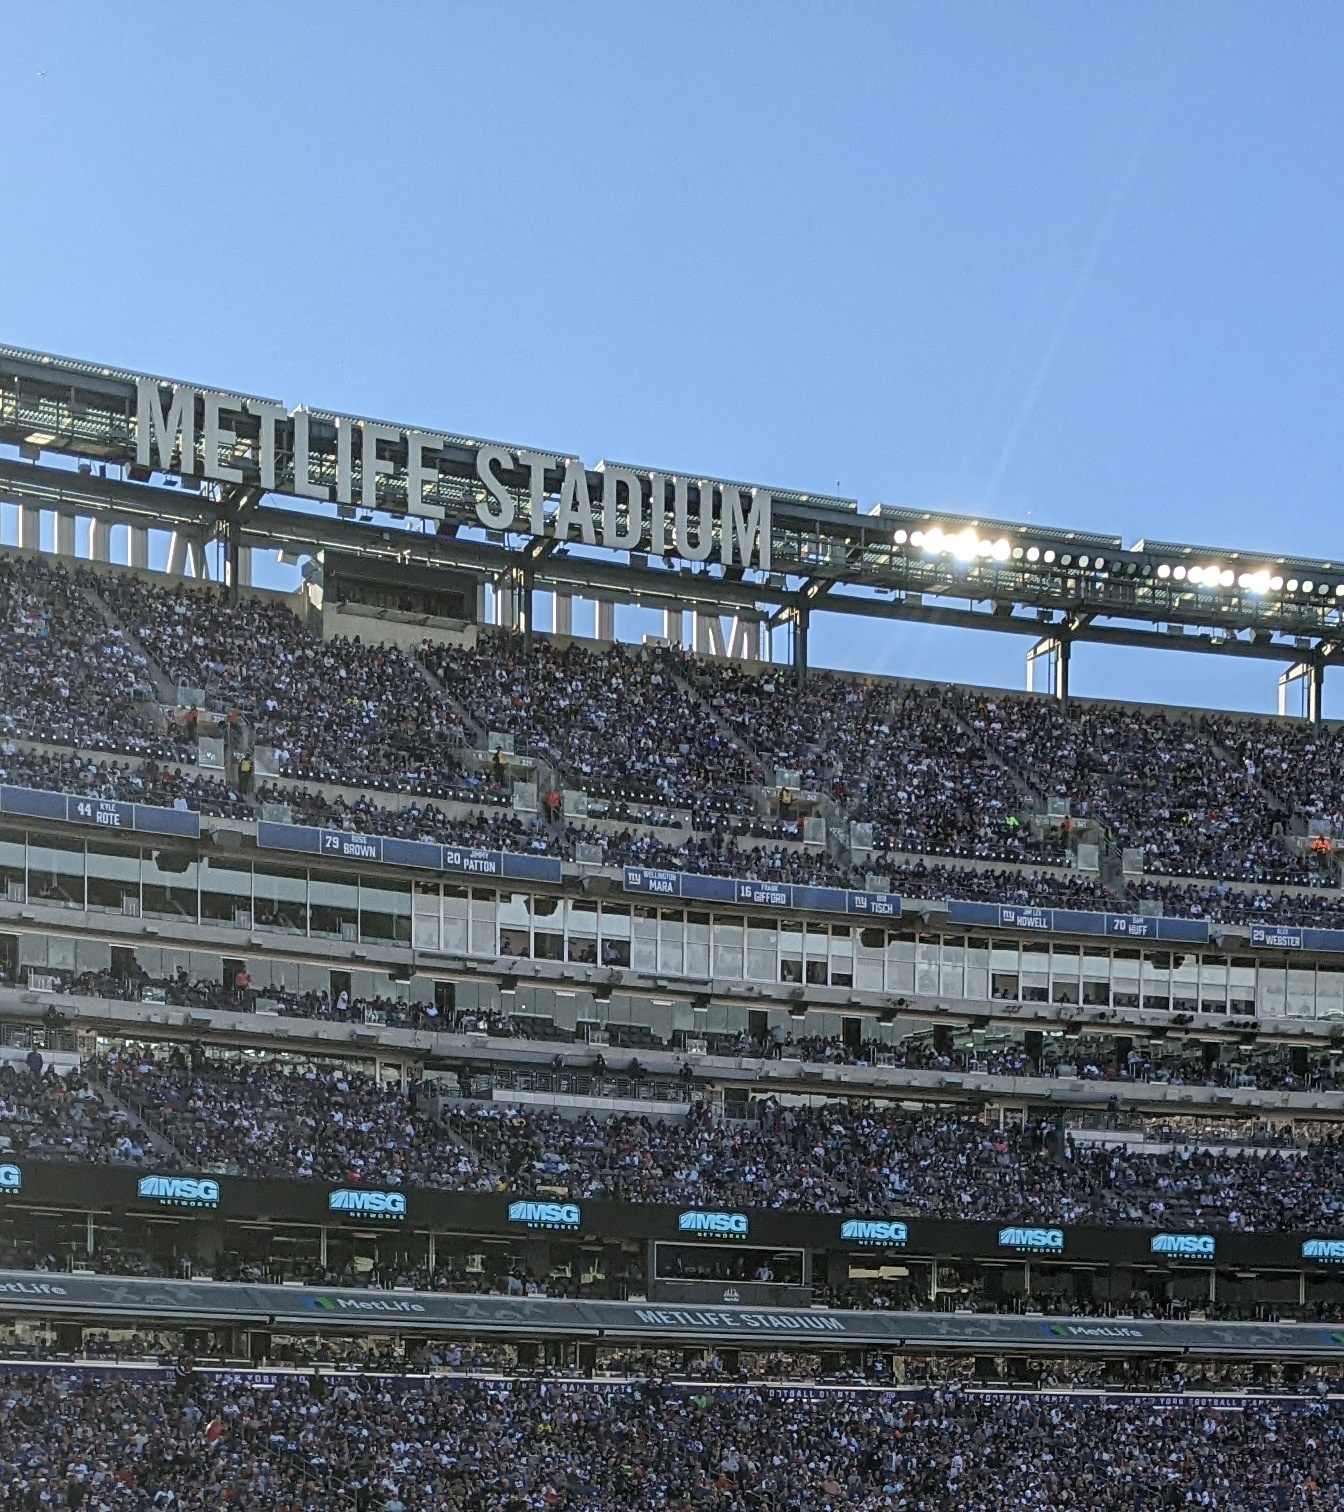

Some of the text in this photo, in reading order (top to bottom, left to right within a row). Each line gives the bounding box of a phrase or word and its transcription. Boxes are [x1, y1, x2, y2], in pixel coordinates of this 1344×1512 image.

[135, 376, 772, 571] METLIFE STADIUM
[77, 802, 92, 817] 44
[96, 810, 120, 826] ROTE
[325, 835, 340, 849] 79
[343, 843, 376, 858] BROWN
[446, 851, 460, 865] 20
[463, 858, 496, 873] PATTON
[649, 879, 674, 893] MARA
[740, 885, 752, 898] 16
[1017, 915, 1048, 929] HOWELL
[1113, 919, 1126, 931] 70
[1265, 934, 1301, 948] WEBSTER
[157, 1177, 219, 1202] MSG
[348, 1191, 406, 1215] MSG
[526, 1202, 581, 1225] MSG
[695, 1212, 749, 1234] MSG
[857, 1222, 907, 1241] MSG
[1015, 1228, 1064, 1249] MSG
[1167, 1235, 1215, 1254] MSG
[337, 1297, 425, 1313] MetLife
[634, 1308, 846, 1331] METLIFE STADIUM
[1067, 1324, 1143, 1338] MetLife
